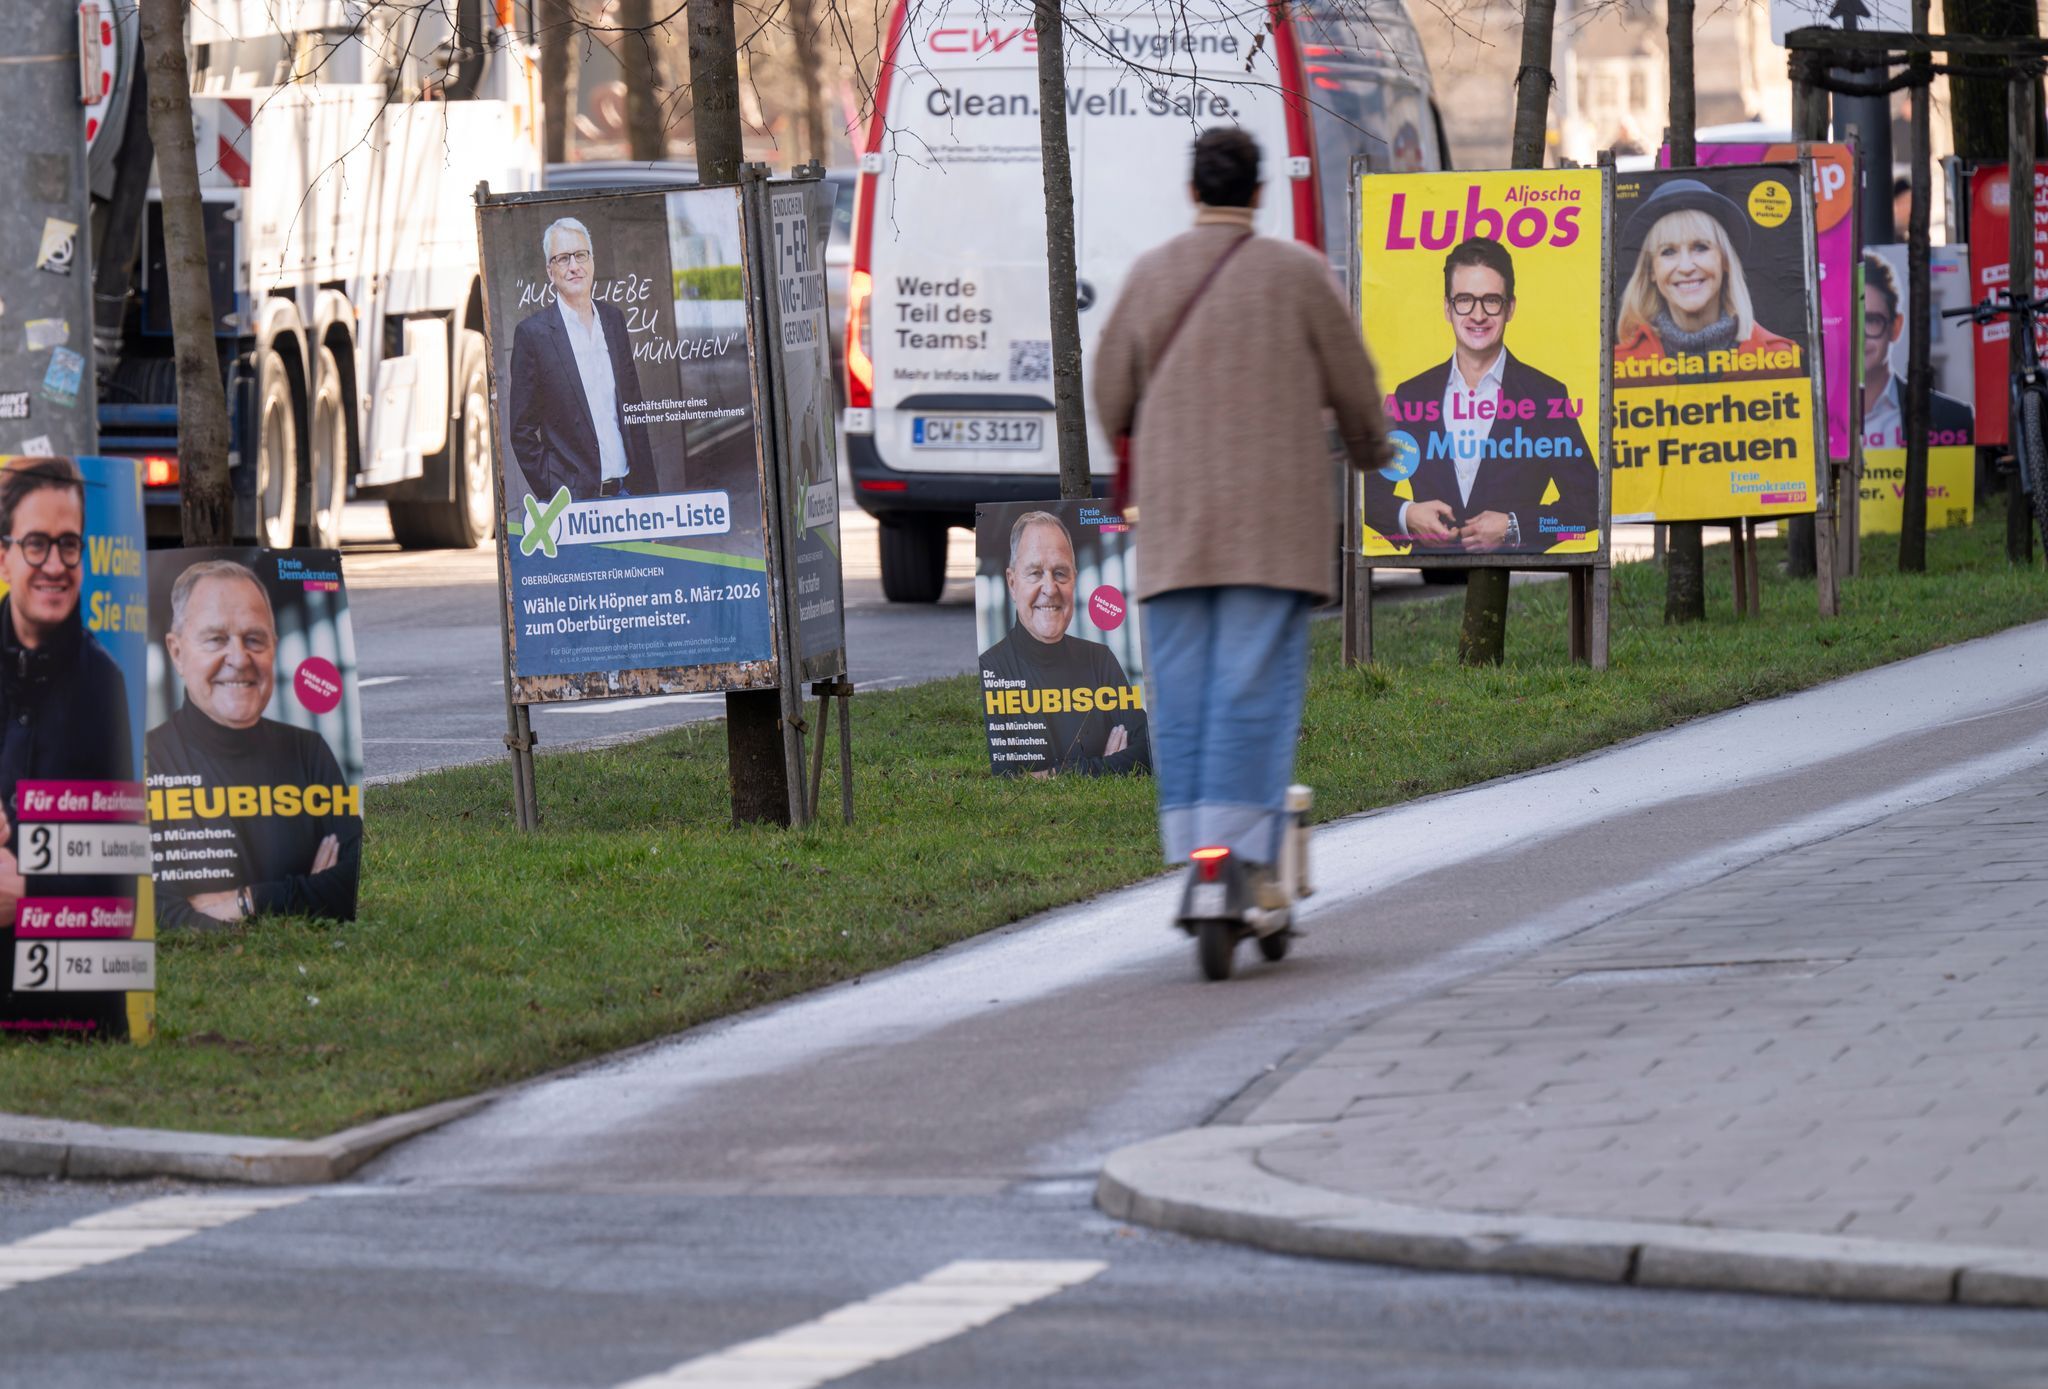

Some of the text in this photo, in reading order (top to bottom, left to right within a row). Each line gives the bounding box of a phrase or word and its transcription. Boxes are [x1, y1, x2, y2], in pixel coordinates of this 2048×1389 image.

[1109, 28, 1239, 58] Hygiene
[926, 89, 1039, 116] Clean.
[1148, 88, 1239, 116] Safe.
[1505, 184, 1581, 206] Aljoscha
[1766, 187, 1776, 198] 3
[1385, 185, 1582, 251] Lubos
[775, 219, 810, 275] 7-ER
[591, 273, 653, 303] LIEBE
[896, 276, 976, 298] Werde
[626, 307, 658, 334] ZU
[896, 303, 992, 324] Teil des
[784, 319, 814, 345] GEFUNDEN
[896, 329, 987, 350] Teams!
[1614, 345, 1801, 379] atricia Riekel
[894, 368, 1001, 381] Mehr Infos hier
[622, 398, 708, 413] Geschäftsführer eines
[1383, 389, 1583, 422] Aus Liebe zu
[624, 407, 745, 425] Münchner Sozialunternehmens
[926, 422, 1037, 442] CW S 3117
[1426, 426, 1583, 461] München.
[1612, 436, 1797, 469] ür Frauen
[1730, 471, 1760, 482] Freie
[1731, 481, 1807, 494] Demokraten
[1788, 493, 1806, 502] FDP
[567, 504, 726, 536] München-Liste
[1080, 507, 1100, 517] Freie
[1539, 517, 1559, 525] Freie
[1539, 524, 1586, 533] Demokraten
[277, 558, 303, 569] Freie
[278, 568, 339, 580] Demokraten
[521, 566, 664, 585] OBERBÜRGERMEISTER FÜR MÜNCHEN
[324, 582, 339, 591] FDP
[523, 583, 761, 615] Wähle Dirk Höpner am 8. März 2026
[1094, 594, 1123, 614] Liste FDP
[87, 591, 122, 632] Sie
[525, 612, 691, 636] zum Oberbürgermeister.
[301, 668, 339, 693] Liste FDP
[983, 670, 995, 679] Dr.
[984, 679, 1026, 689] Wolfgang
[985, 685, 1142, 715] HEUBISCH
[989, 721, 1046, 731] Aus München.
[991, 737, 1048, 746] Wie München.
[993, 751, 1046, 761] Für München.
[146, 774, 202, 787] olfgang
[23, 789, 54, 811] Für
[57, 789, 88, 811] den
[164, 828, 236, 842] München.
[26, 825, 52, 872] 3
[67, 840, 92, 857] 601
[101, 840, 129, 857] Lubos
[166, 848, 238, 861] München.
[162, 867, 234, 881] München.
[21, 907, 52, 928] Für
[55, 907, 87, 928] den
[23, 943, 49, 988] 3
[66, 958, 92, 974] 762
[102, 957, 129, 974] Lubos
